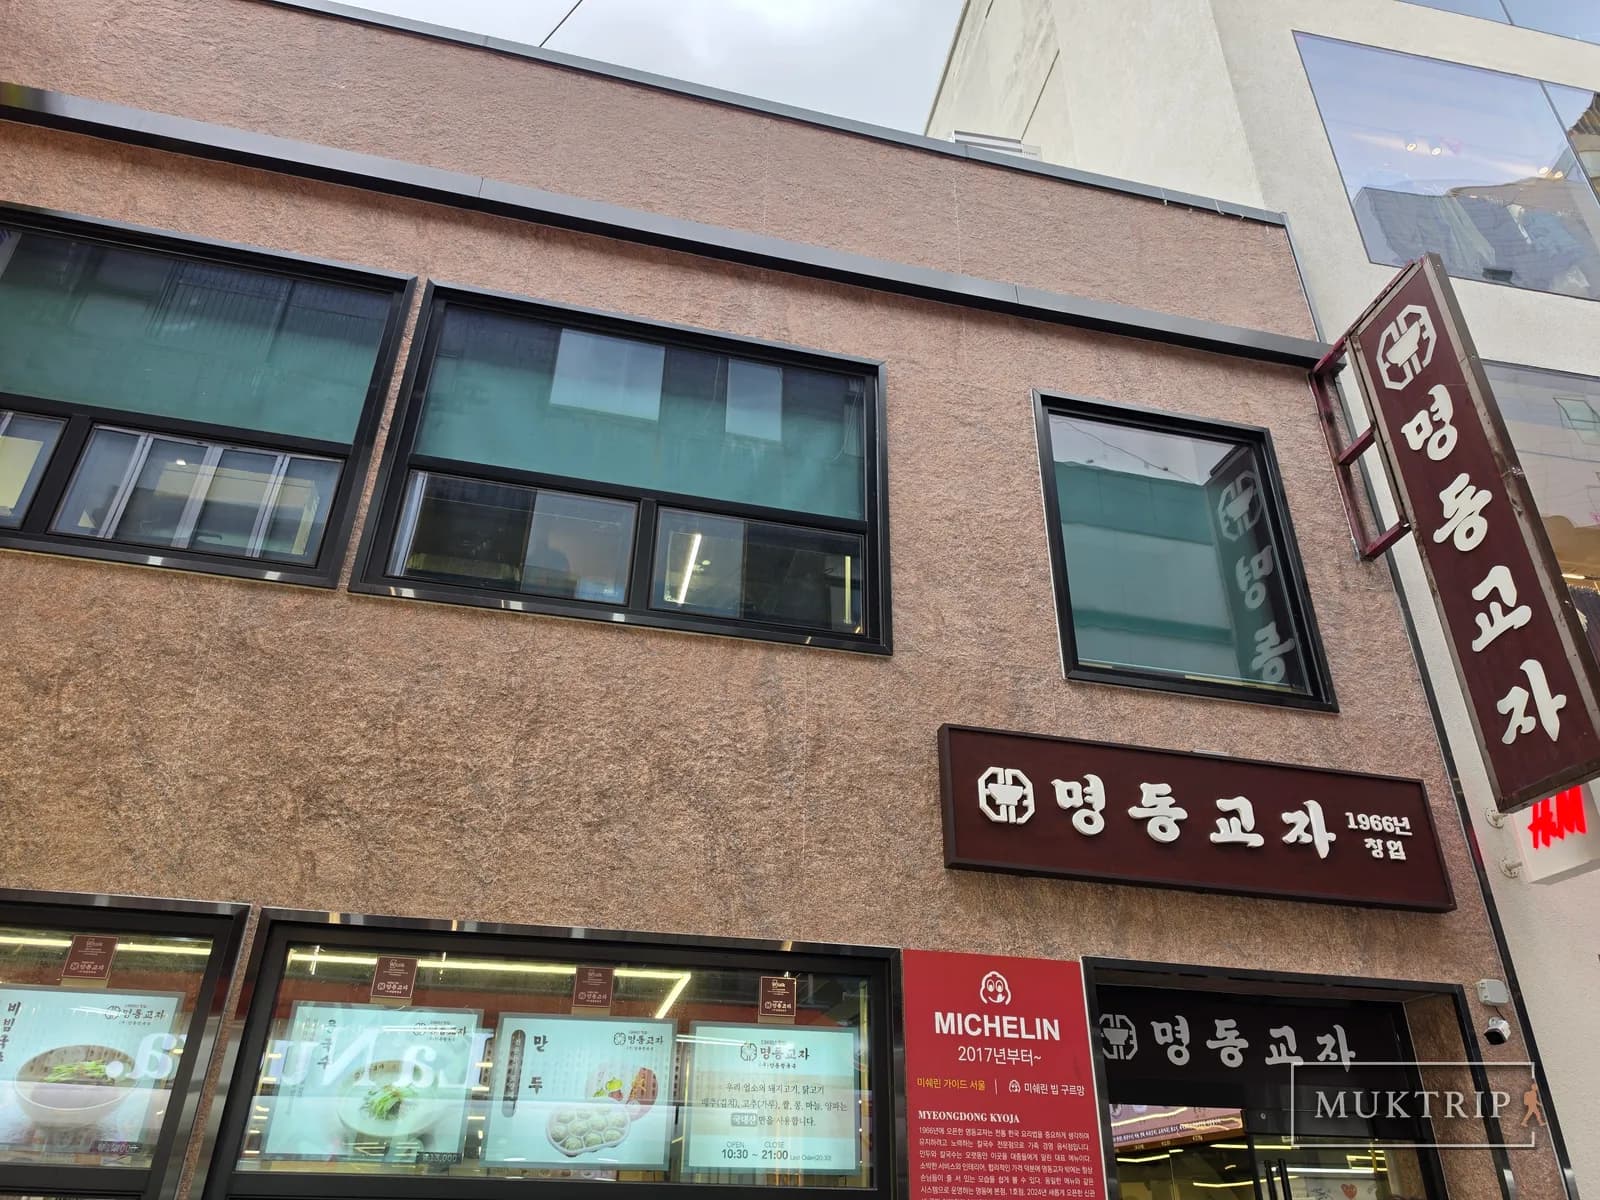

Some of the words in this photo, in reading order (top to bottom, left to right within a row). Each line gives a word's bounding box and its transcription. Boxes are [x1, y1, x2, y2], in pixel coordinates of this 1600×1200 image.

[1400, 384, 1568, 745] 명동교자
[1051, 773, 1337, 860] 명동교자
[1347, 810, 1415, 839] 1966년
[1364, 836, 1408, 862] 창업
[934, 1011, 1060, 1041] MICHELIN
[958, 1046, 1042, 1066] 2017년부터~
[1150, 1014, 1356, 1073] 명동교자
[917, 1078, 942, 1089] 미쉐린
[944, 1079, 968, 1089] 가이드
[970, 1080, 986, 1091] 서울
[1024, 1083, 1048, 1094] 미쉐린
[1061, 1084, 1086, 1096] 구르망
[918, 1110, 988, 1122] MYEONGDONG
[990, 1112, 1020, 1124] KYOJA
[722, 1149, 748, 1159] 10:30
[762, 1150, 788, 1160] 21:00
